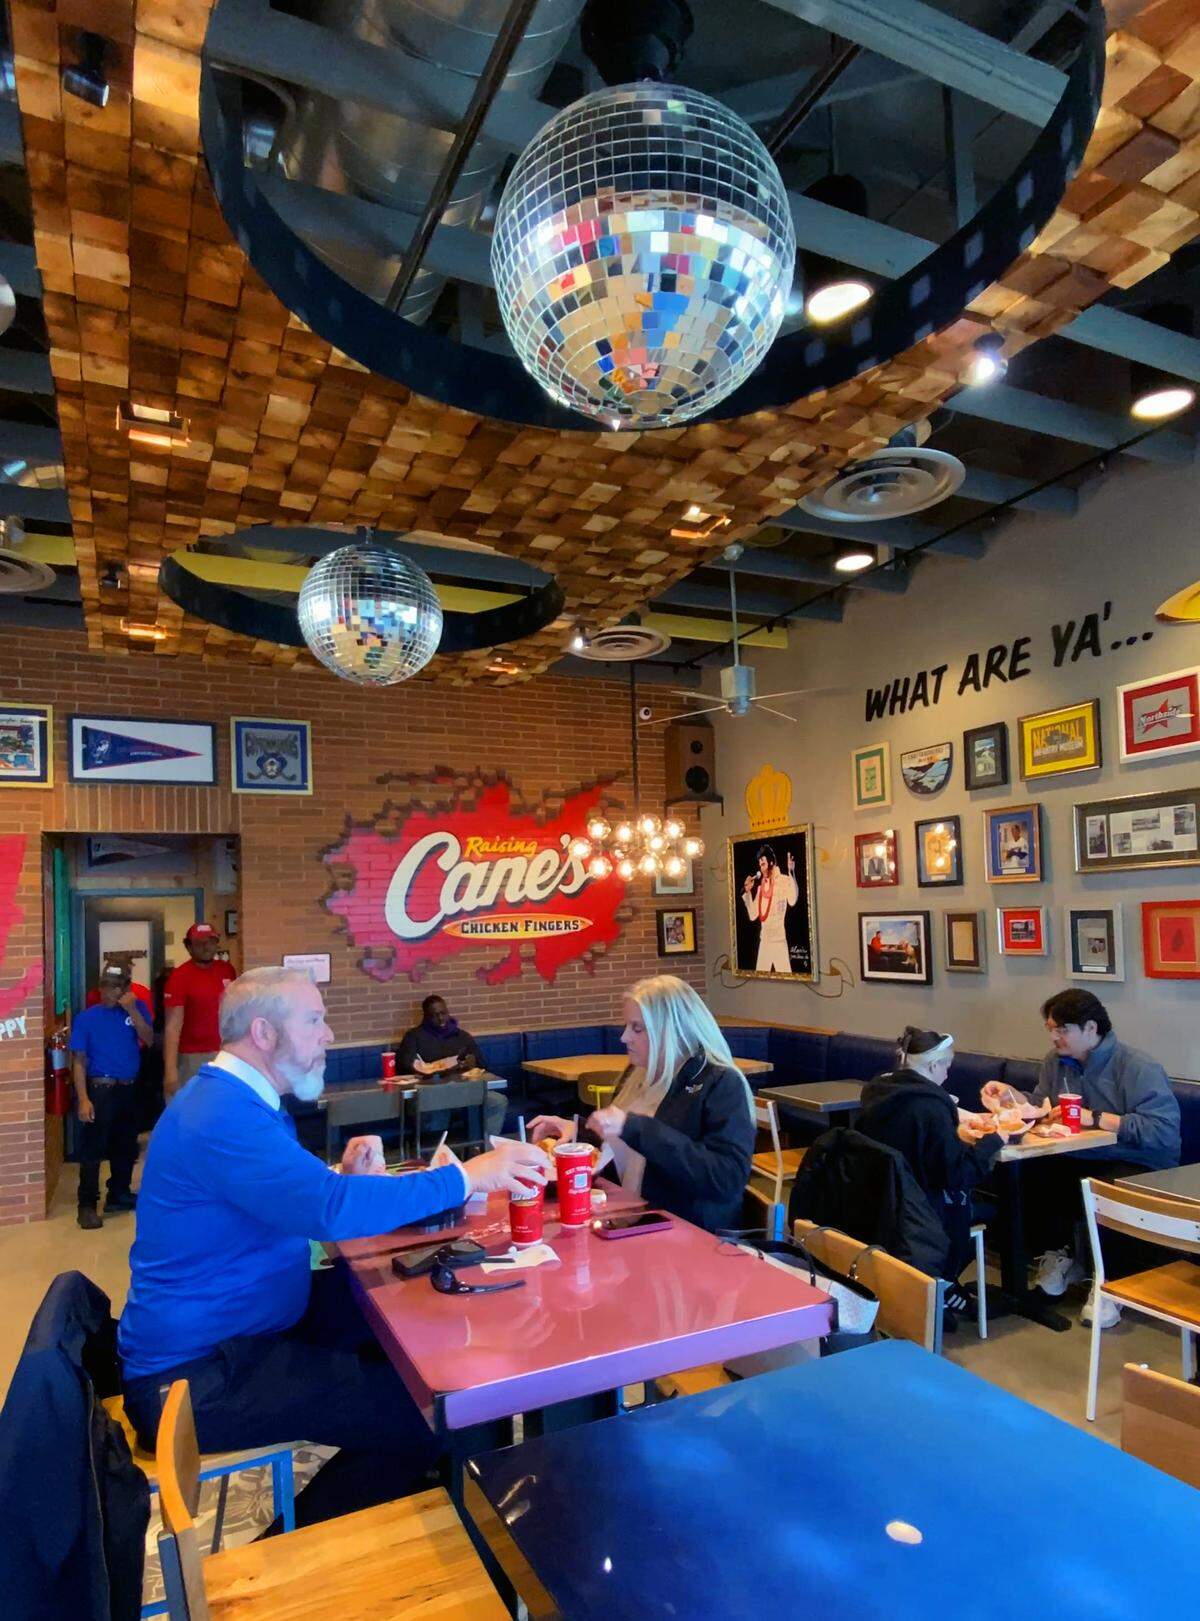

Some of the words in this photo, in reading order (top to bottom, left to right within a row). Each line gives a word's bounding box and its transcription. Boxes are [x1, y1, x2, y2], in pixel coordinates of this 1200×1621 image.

[865, 664, 948, 722] WHAT
[957, 637, 1031, 696] ARE
[463, 836, 538, 858] Raising
[384, 831, 594, 939] Cane's
[461, 921, 519, 934] CHICKEN
[524, 919, 579, 932] FINGERS
